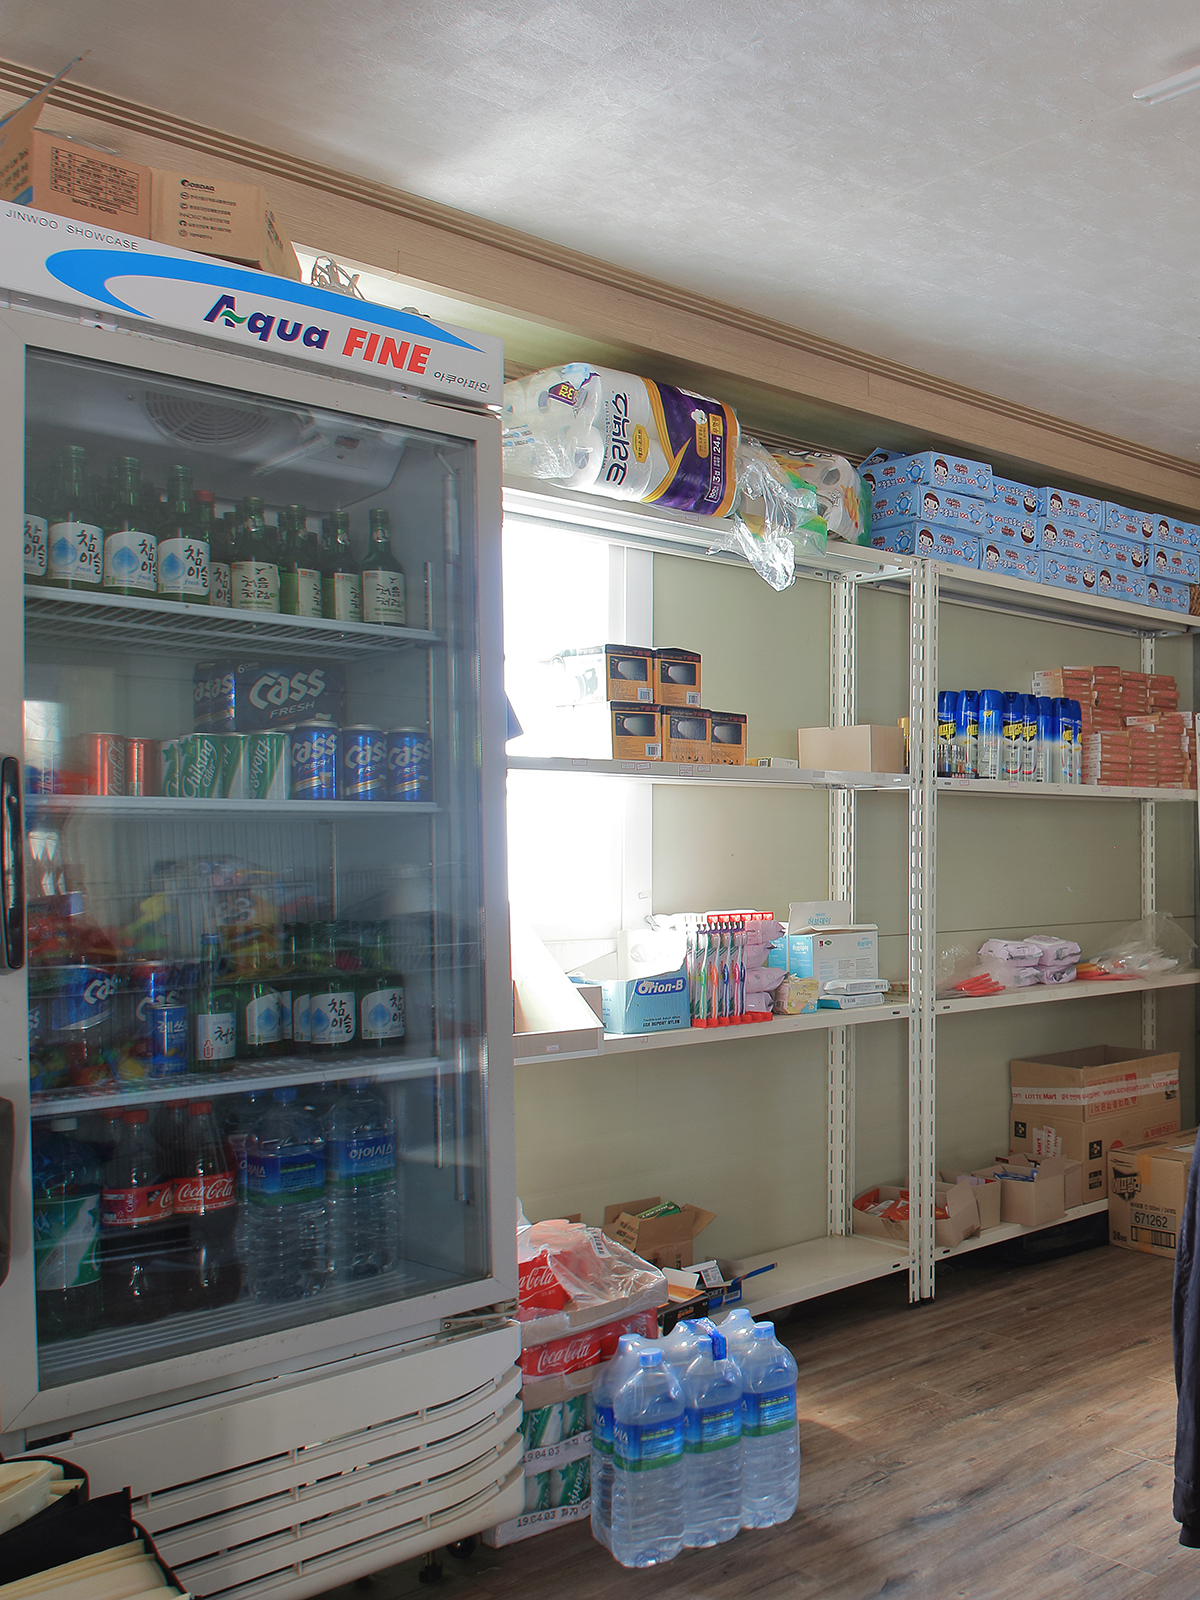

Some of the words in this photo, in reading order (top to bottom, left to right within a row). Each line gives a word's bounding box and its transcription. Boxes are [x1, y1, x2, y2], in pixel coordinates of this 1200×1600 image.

[5, 209, 59, 230] JINWOO
[66, 224, 139, 251] SHOWCASE
[203, 294, 331, 351] Aqua
[341, 327, 432, 375] FINE
[433, 369, 492, 394] 아쿠아파인
[605, 392, 631, 486] 크리넥스
[269, 701, 315, 719] FRESH
[638, 979, 684, 994] Orion-B
[349, 1144, 393, 1160] 아이시스
[1134, 1211, 1168, 1229] 671262
